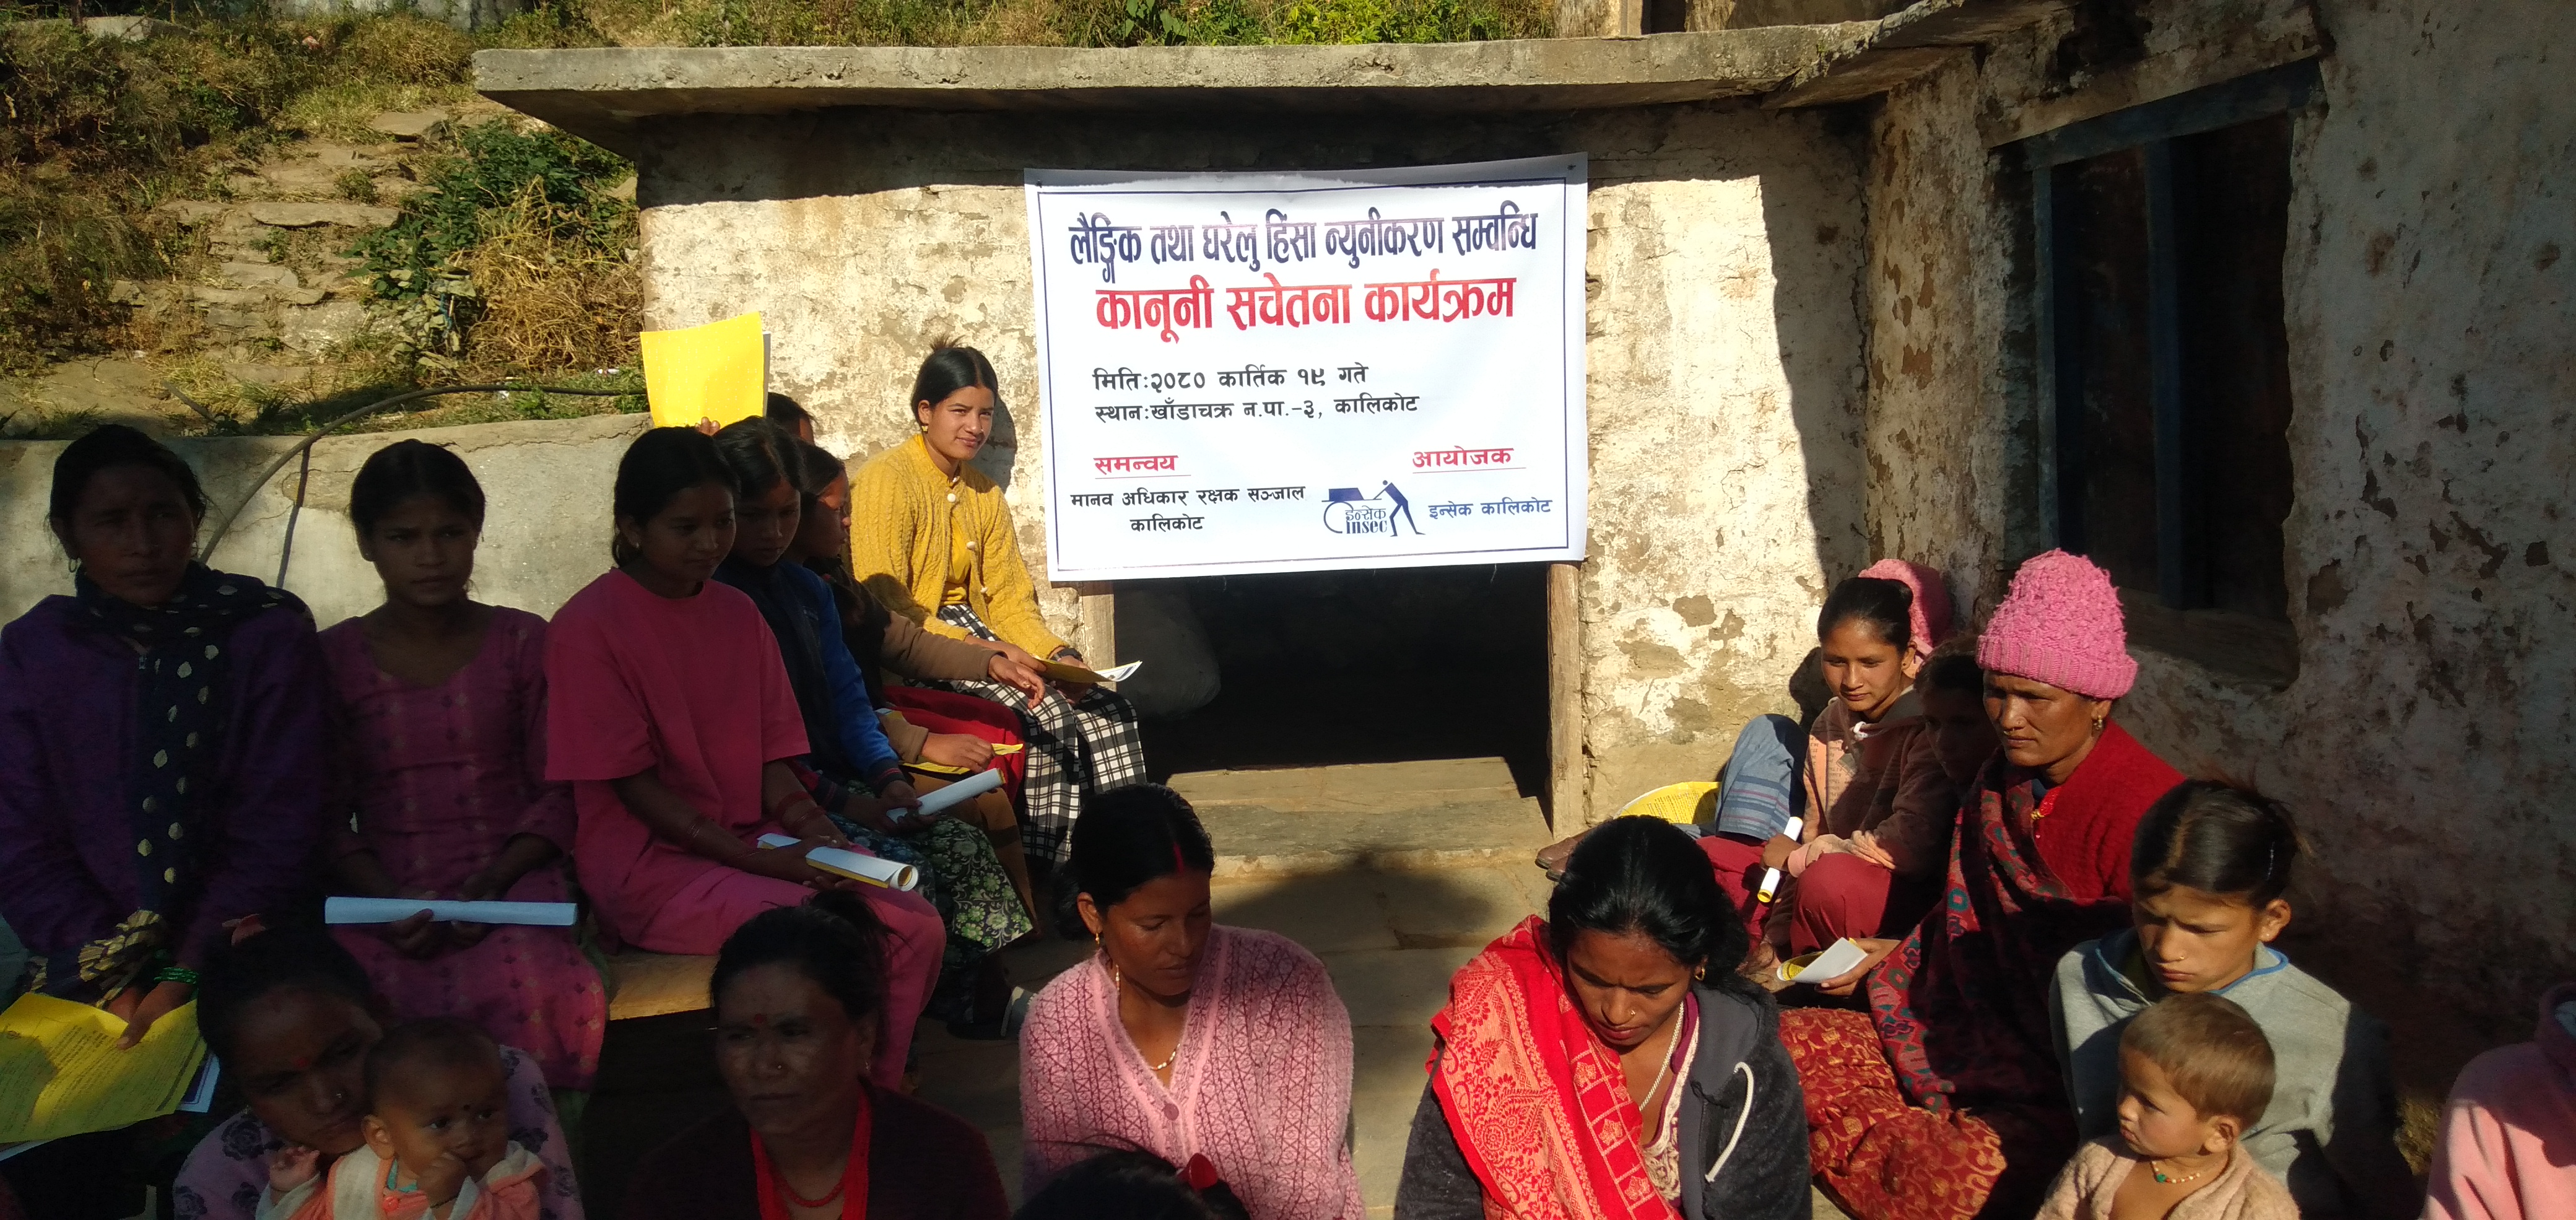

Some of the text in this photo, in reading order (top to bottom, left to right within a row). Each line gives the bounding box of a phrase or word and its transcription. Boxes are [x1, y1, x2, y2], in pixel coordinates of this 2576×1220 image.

[1068, 212, 1142, 284] लैङ्गिक
[1150, 224, 1194, 264] तथा
[1202, 211, 1261, 272] घरेलु
[1265, 208, 1316, 263] हिंसा
[1325, 206, 1445, 269] न्युनीकरण
[1095, 268, 1517, 344] कानूनी सचेतना कार्यक्रम
[1217, 364, 1287, 388] कार्तिक
[1297, 368, 1325, 386] १९
[1337, 362, 1369, 384] गते
[1333, 392, 1420, 414] कालिकोट
[1093, 455, 1179, 475] समन्वय
[1412, 445, 1515, 468] आयोजक
[1070, 486, 1306, 507] मानव अधिकार रक्षक सञ्जाल
[1428, 497, 1553, 520] इन्सेक कालिकोट
[1129, 513, 1205, 533] कालिकोट
